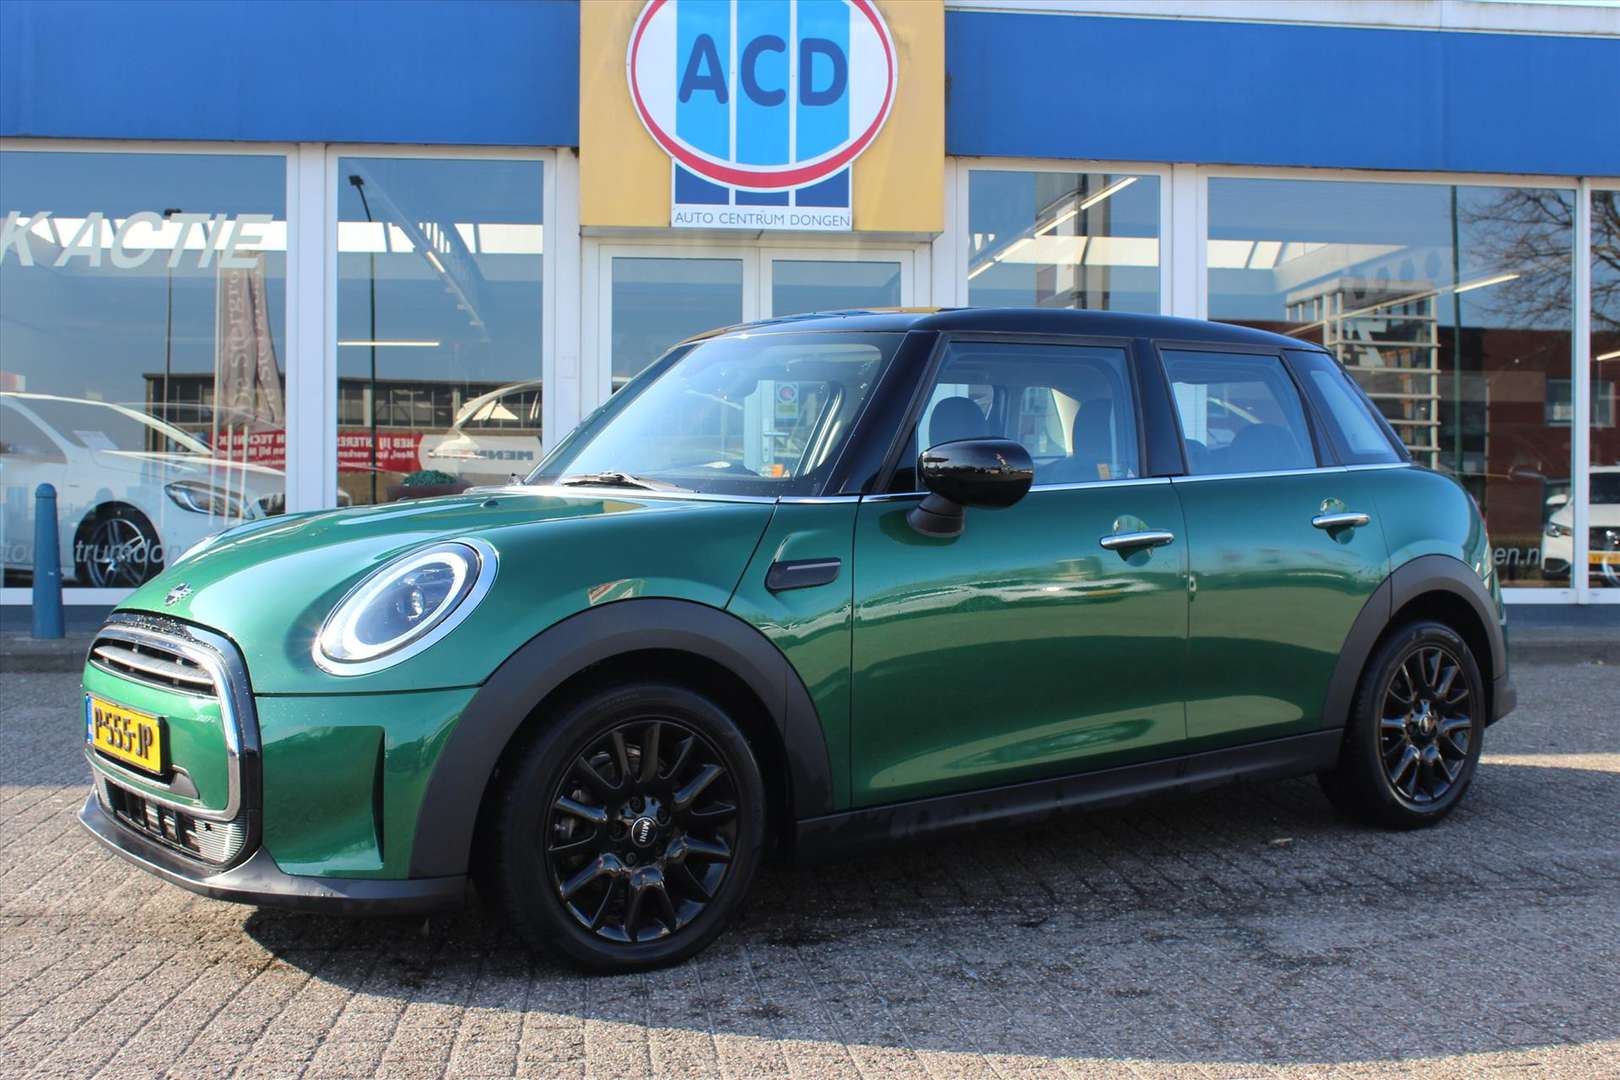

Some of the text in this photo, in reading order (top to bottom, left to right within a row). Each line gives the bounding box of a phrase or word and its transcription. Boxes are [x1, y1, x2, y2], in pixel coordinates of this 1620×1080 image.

[678, 33, 848, 107] ACD
[674, 212, 850, 227] AUTO CENTRUM DONGEN
[54, 211, 273, 269] ACTIE
[639, 820, 651, 843] MINI
